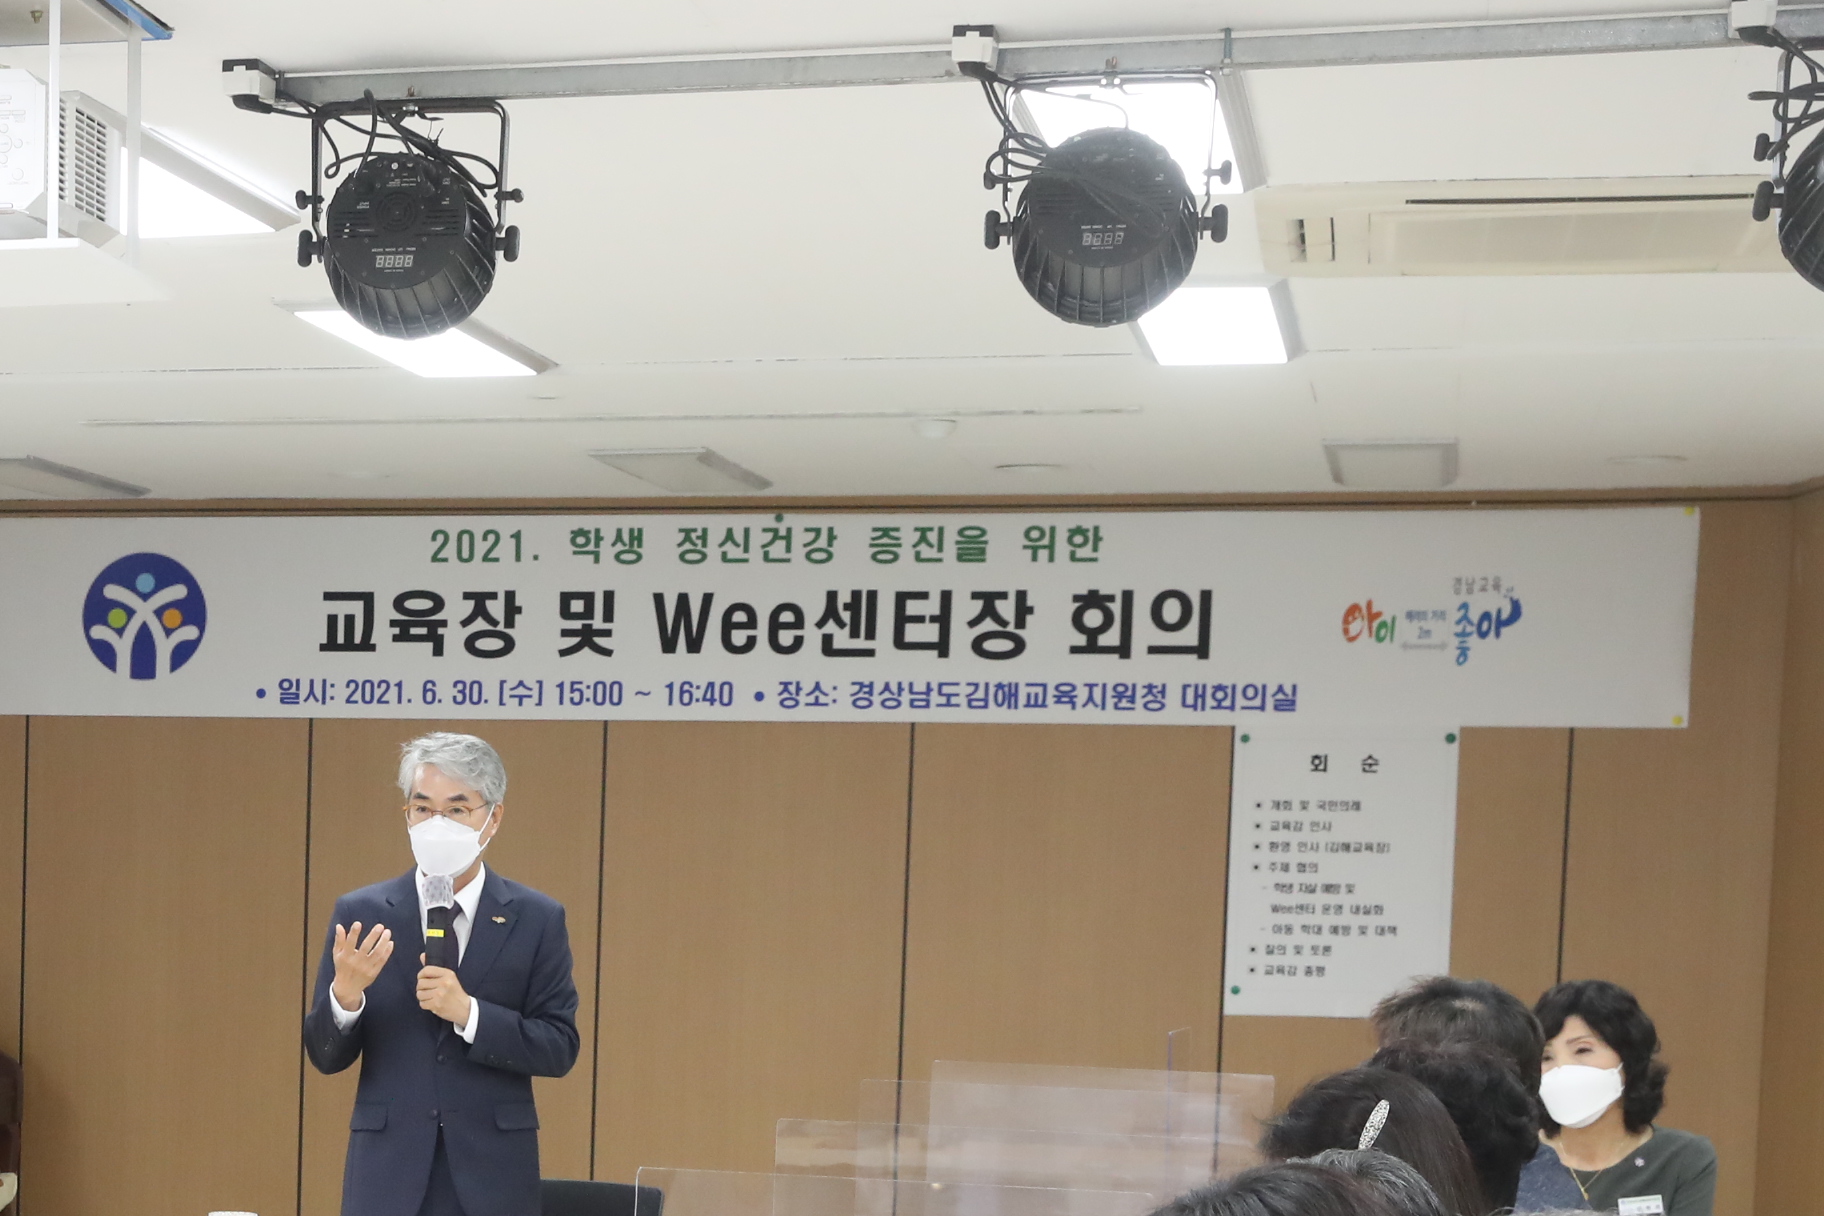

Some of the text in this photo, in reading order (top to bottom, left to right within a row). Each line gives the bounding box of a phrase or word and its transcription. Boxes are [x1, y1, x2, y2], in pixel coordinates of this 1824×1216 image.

[431, 524, 1104, 565] 2021. 학생 정신건강 증진을 위한
[319, 588, 1213, 661] 교육장 및 Wee센터장 회의
[278, 678, 336, 706] 일시:
[345, 679, 412, 705] 2021.
[422, 680, 443, 705] 6.
[452, 680, 489, 706] 30.
[498, 679, 543, 708] [수]
[555, 680, 624, 707] 15:00
[664, 680, 734, 707] 16:40
[777, 680, 1298, 713] 장소: 경상남도김해교육지원청 대회의실
[1310, 754, 1380, 774] 회 순
[1270, 820, 1333, 832] 교육감 인사
[1297, 841, 1320, 853] 인사
